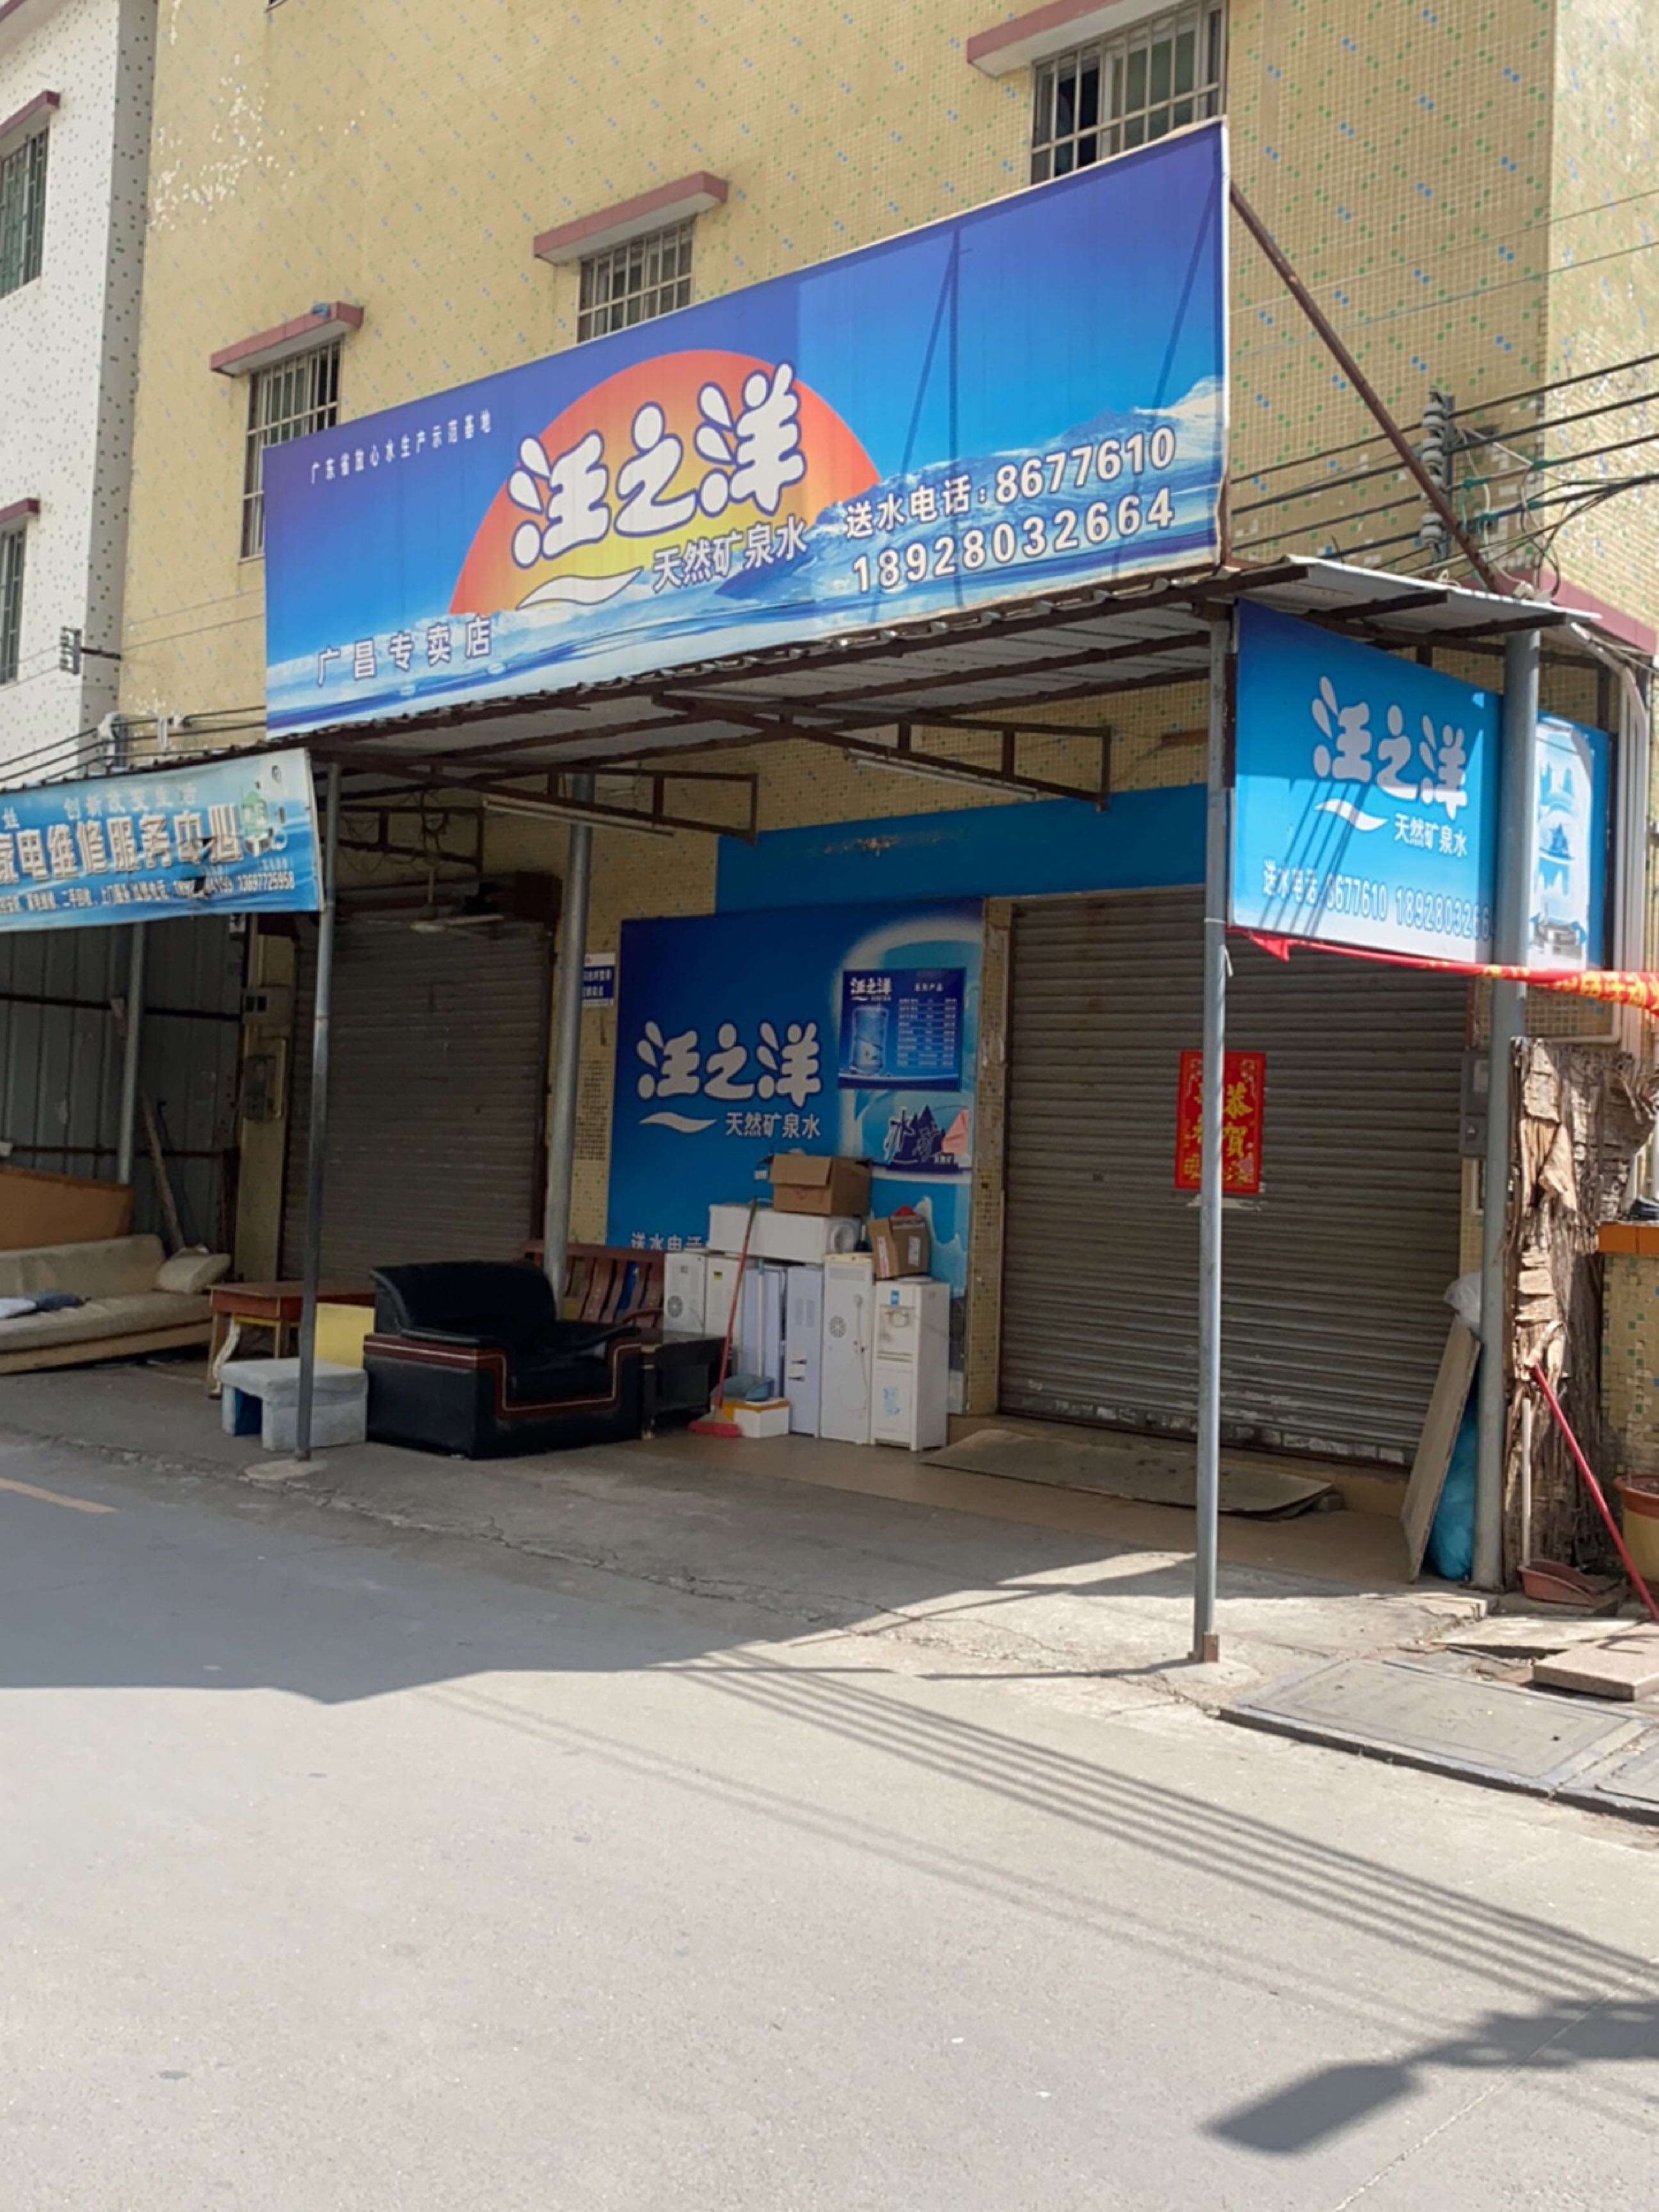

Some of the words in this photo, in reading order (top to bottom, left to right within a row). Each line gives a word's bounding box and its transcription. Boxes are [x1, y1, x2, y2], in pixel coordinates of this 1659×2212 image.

[507, 362, 806, 568] 汪之洋
[651, 515, 808, 593] 天然矿泉水
[853, 488, 1174, 594] 18928032664
[317, 615, 492, 687] 广昌专卖店
[1311, 676, 1468, 820] 汪之洋
[1394, 813, 1467, 858] 天然矿泉水
[1263, 859, 1318, 905] 送水电话
[1326, 874, 1388, 922] 8677610
[1396, 885, 1495, 942] 1892803266
[636, 1020, 822, 1107] 汪之洋
[725, 1111, 821, 1139] 天然矿泉水
